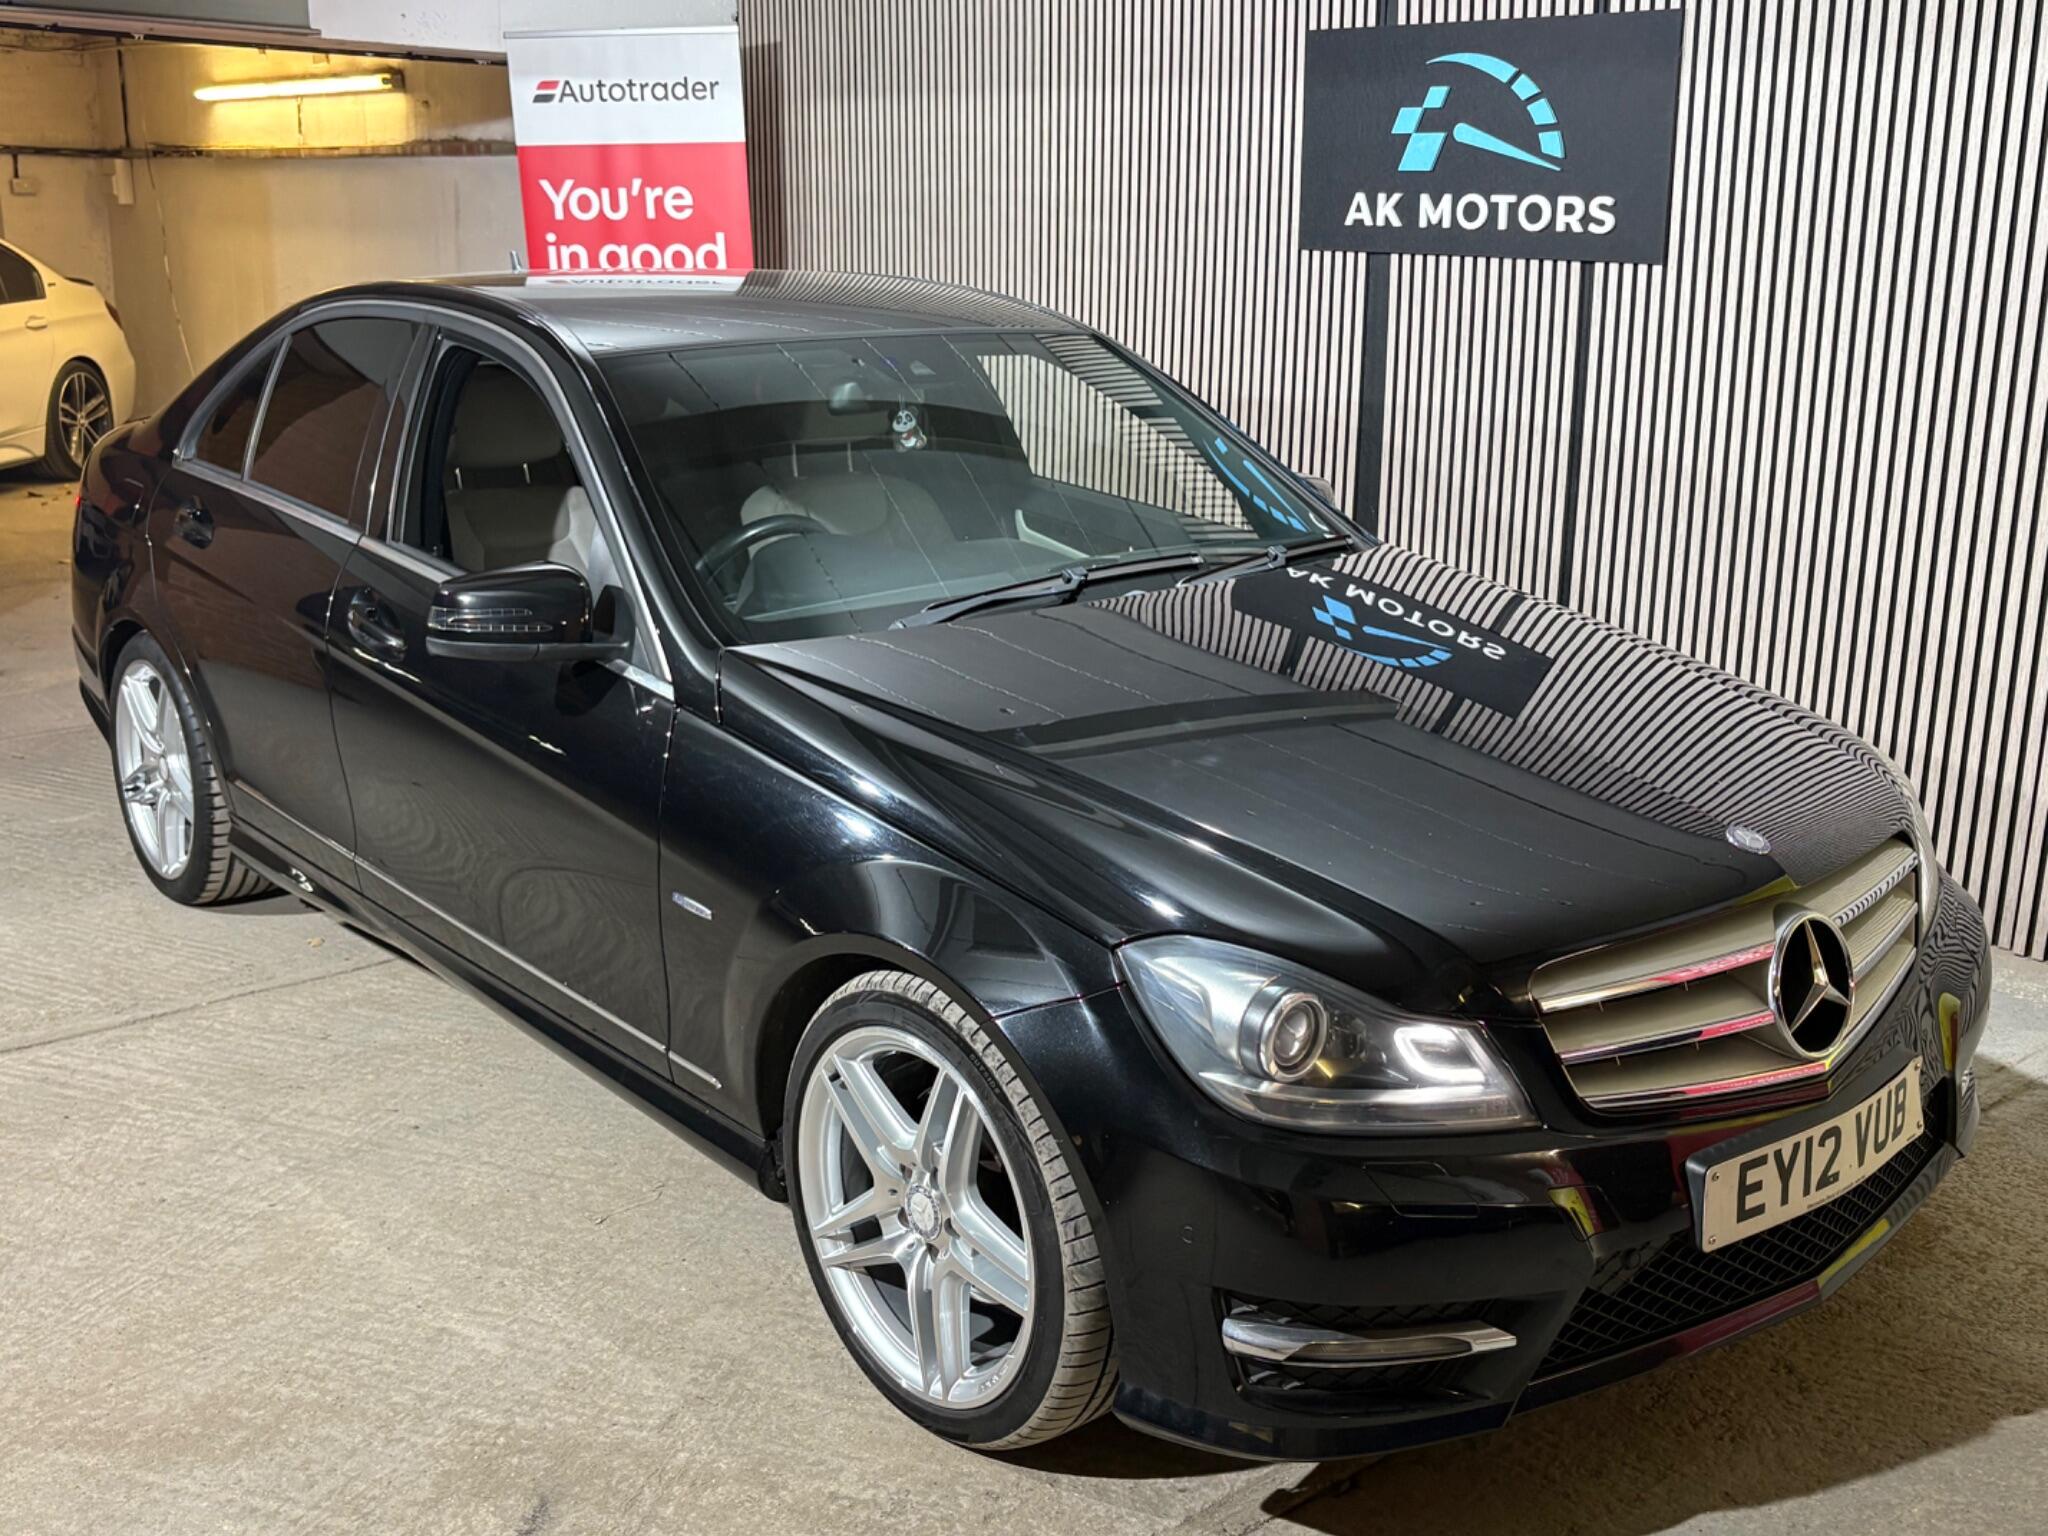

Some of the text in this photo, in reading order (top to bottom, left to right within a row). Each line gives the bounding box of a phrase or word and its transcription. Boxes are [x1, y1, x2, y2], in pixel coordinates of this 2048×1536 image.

[558, 76, 719, 103] Autotrader
[538, 177, 695, 222] You're
[1344, 191, 1617, 235] AK MOTORS
[545, 232, 589, 270] in
[1736, 1078, 1907, 1225] EY12 VUB
